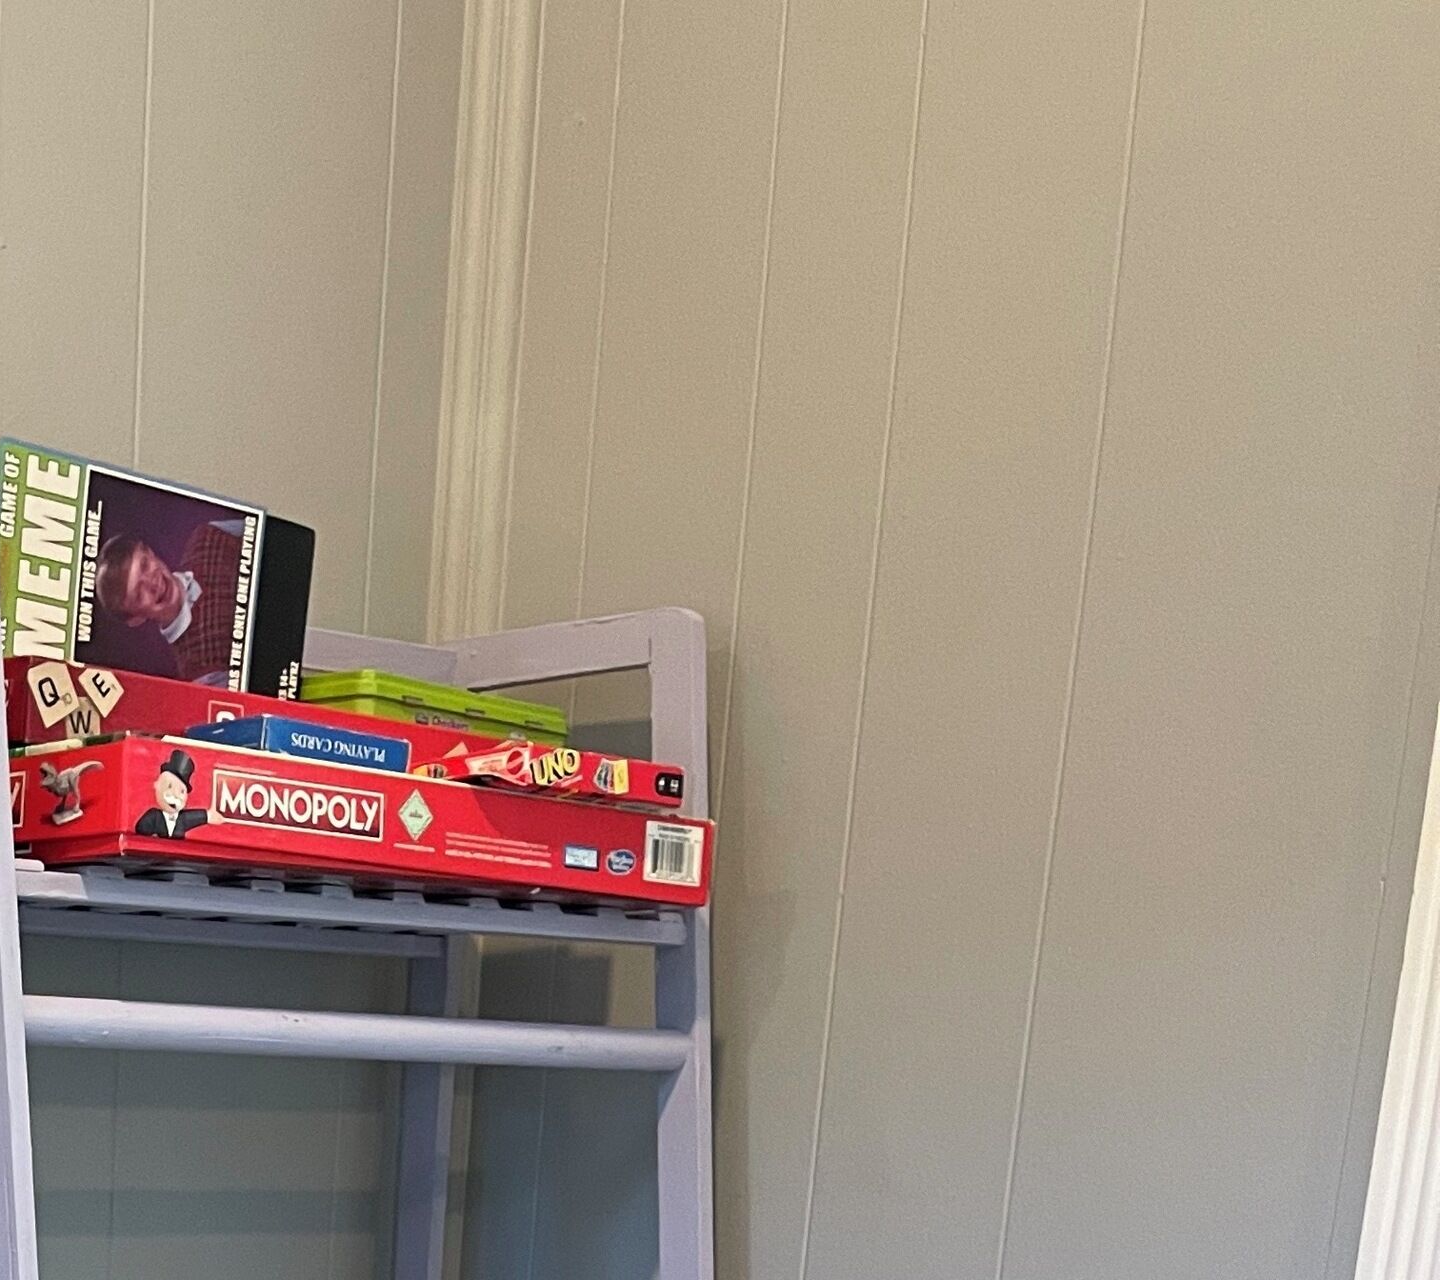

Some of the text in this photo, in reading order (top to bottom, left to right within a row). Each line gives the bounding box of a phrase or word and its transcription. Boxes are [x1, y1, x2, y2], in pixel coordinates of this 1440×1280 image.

[0, 451, 21, 538] GAME OF
[12, 454, 81, 660] MEME
[81, 560, 96, 599] THIS
[231, 516, 257, 665] THE ONLY ONE PLAYING
[77, 602, 93, 642] WON
[37, 676, 60, 709] Q
[91, 673, 111, 699] E
[70, 710, 93, 735] W
[431, 714, 470, 732] Checkers
[290, 731, 386, 764] PLAYING CARDS
[528, 748, 581, 788] UNO
[219, 781, 379, 832] MONOPOLY
